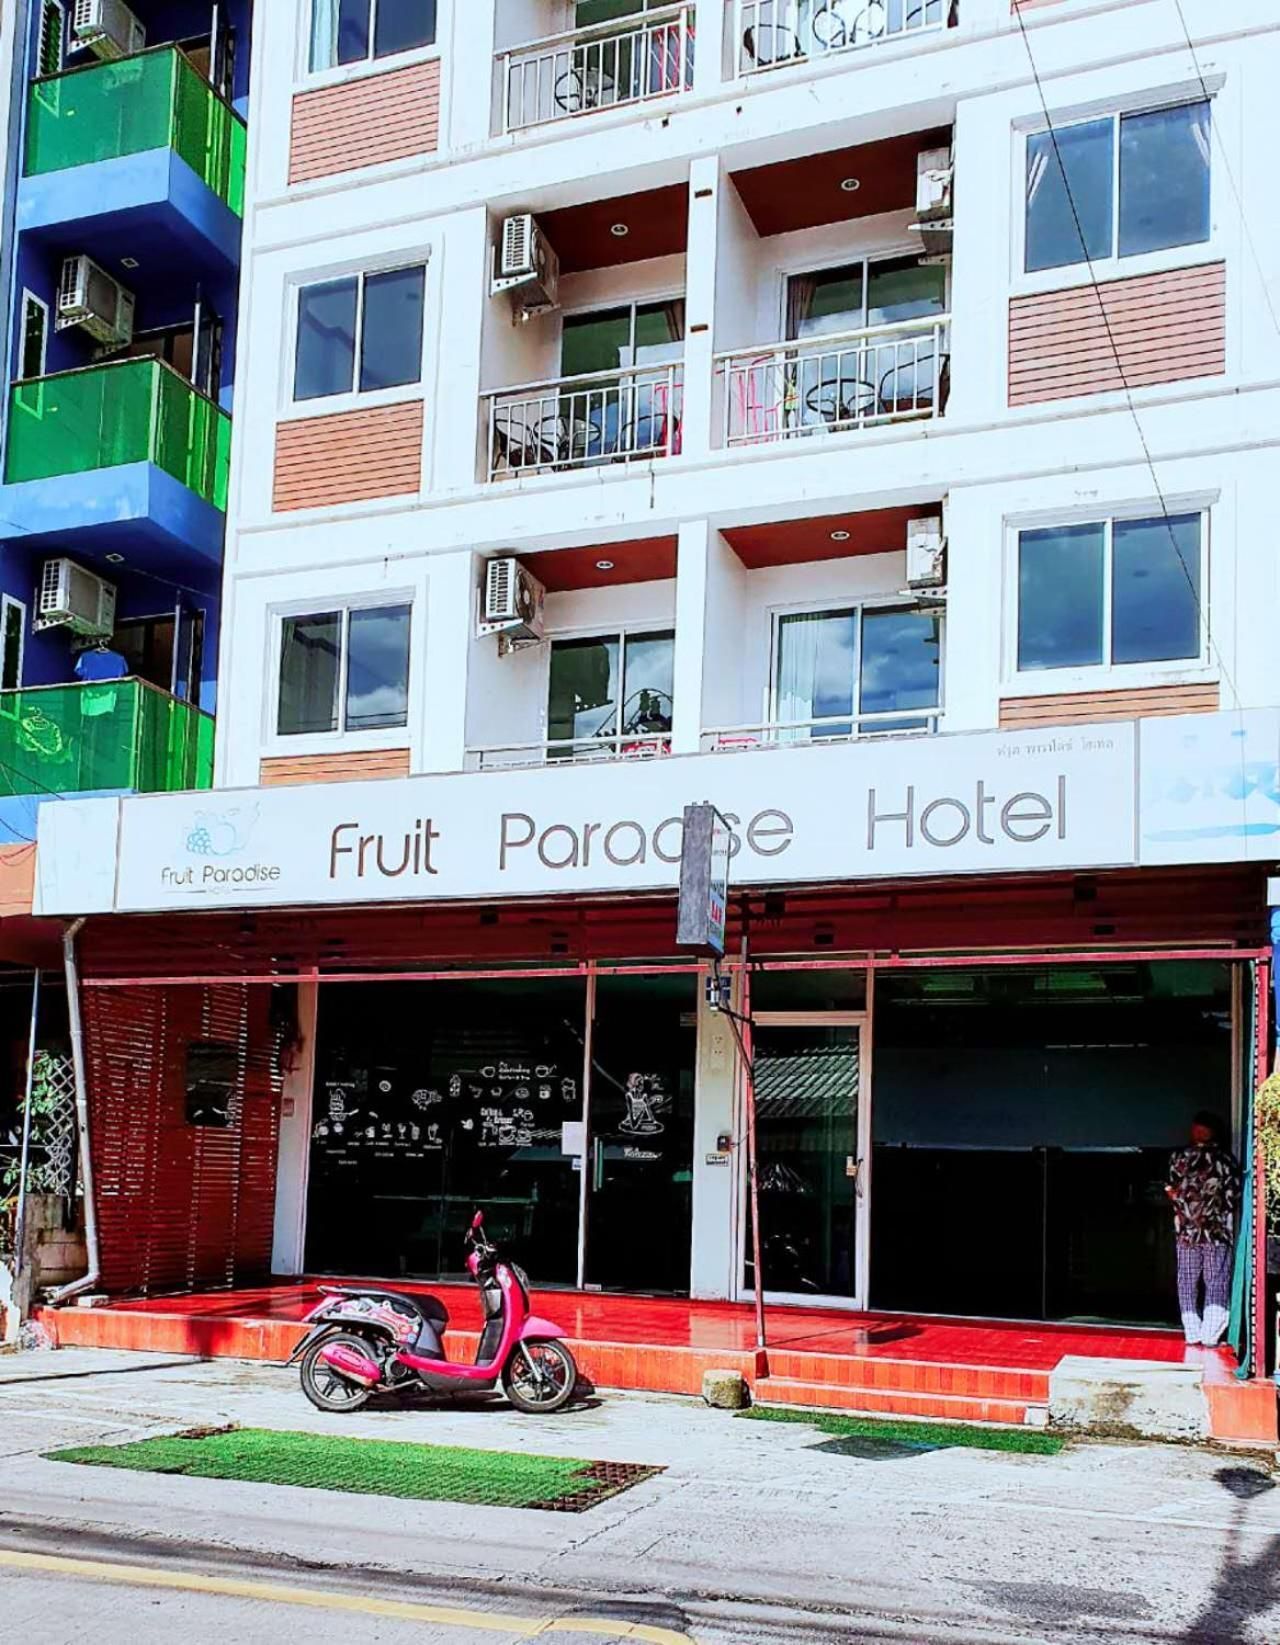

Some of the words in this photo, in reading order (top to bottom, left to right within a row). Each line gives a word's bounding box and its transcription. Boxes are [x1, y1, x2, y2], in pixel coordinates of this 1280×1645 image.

[330, 818, 440, 878] Fruit
[499, 808, 794, 870] Parase
[867, 775, 1066, 850] Hotel
[161, 866, 193, 885] Fruit
[203, 864, 280, 883] Paradise
